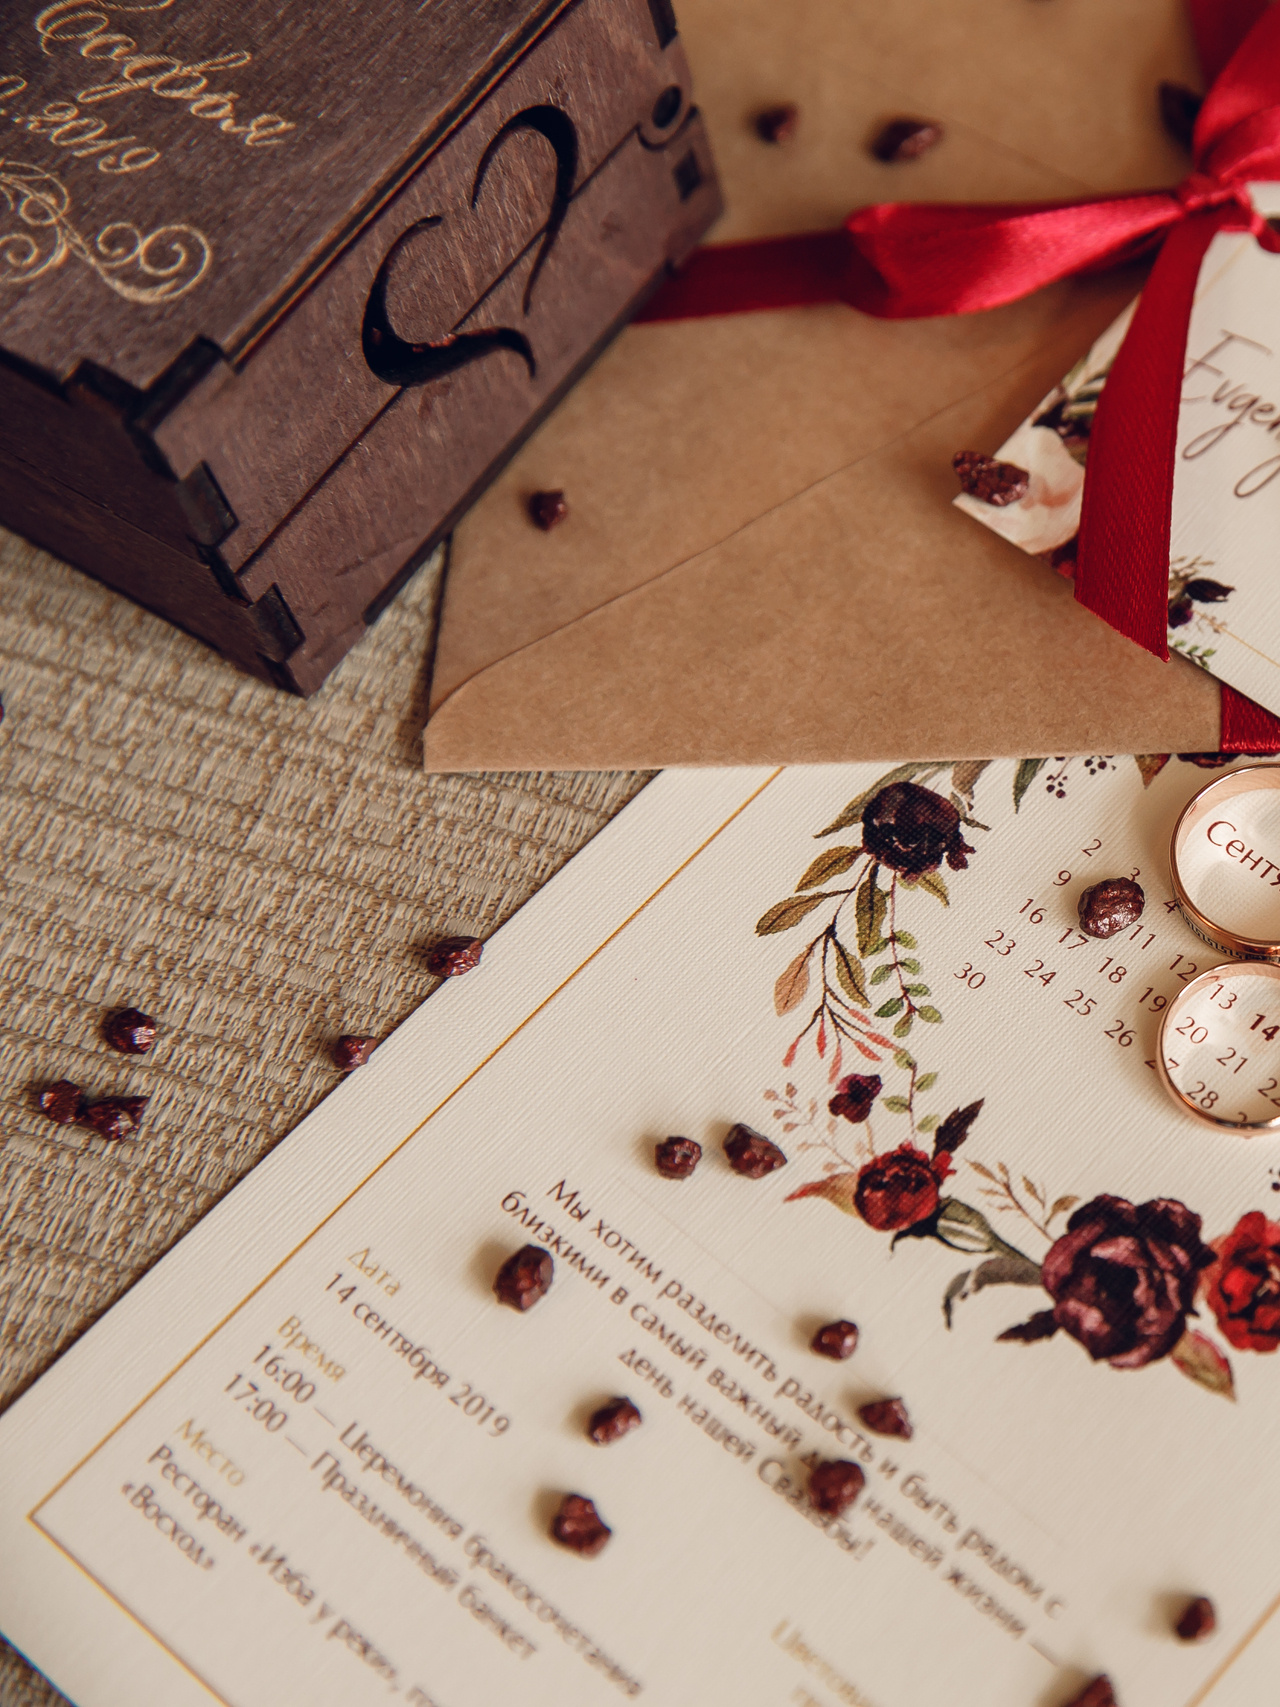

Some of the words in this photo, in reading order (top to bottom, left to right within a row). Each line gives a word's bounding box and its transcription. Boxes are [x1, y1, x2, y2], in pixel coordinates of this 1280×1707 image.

[1082, 838, 1103, 857] 2
[953, 962, 986, 990] 30
[1018, 897, 1048, 925] 16
[1058, 927, 1089, 951] 17
[1098, 957, 1128, 984] 18
[1138, 987, 1167, 1013] 19
[1175, 1016, 1209, 1044] 20
[1216, 1047, 1248, 1074] 21
[1053, 870, 1072, 888] 9
[1129, 924, 1156, 949] 11
[1169, 954, 1198, 981] 12
[1209, 984, 1238, 1010] 13
[1250, 1013, 1280, 1042] 14
[984, 930, 1016, 957] 23
[1024, 959, 1058, 987] 24
[1064, 990, 1098, 1016] 25
[1104, 1020, 1137, 1047] 26
[1186, 1081, 1219, 1109] 28
[347, 1246, 402, 1296] Дата
[500, 1189, 610, 1288] близкими
[610, 1287, 629, 1305] в
[629, 1302, 709, 1370] самый
[705, 1366, 804, 1451] важный
[223, 1373, 288, 1433] 17:00
[277, 1314, 347, 1383] Время
[325, 1272, 357, 1304] 14
[352, 1302, 450, 1394] сентября
[449, 1383, 511, 1438] 2019
[548, 1179, 589, 1222] Мы
[591, 1219, 662, 1284] хотим
[659, 1277, 778, 1384] разделить
[778, 1375, 877, 1463] радость
[878, 1458, 901, 1480] и
[900, 1474, 960, 1534] быть
[959, 1527, 1042, 1600] рядом
[618, 1345, 675, 1398] день
[675, 1392, 756, 1466] нашей
[147, 1444, 248, 1542] Ресторан
[175, 1417, 247, 1487] Место
[252, 1344, 316, 1404] 16:00
[339, 1422, 463, 1539] Церемония
